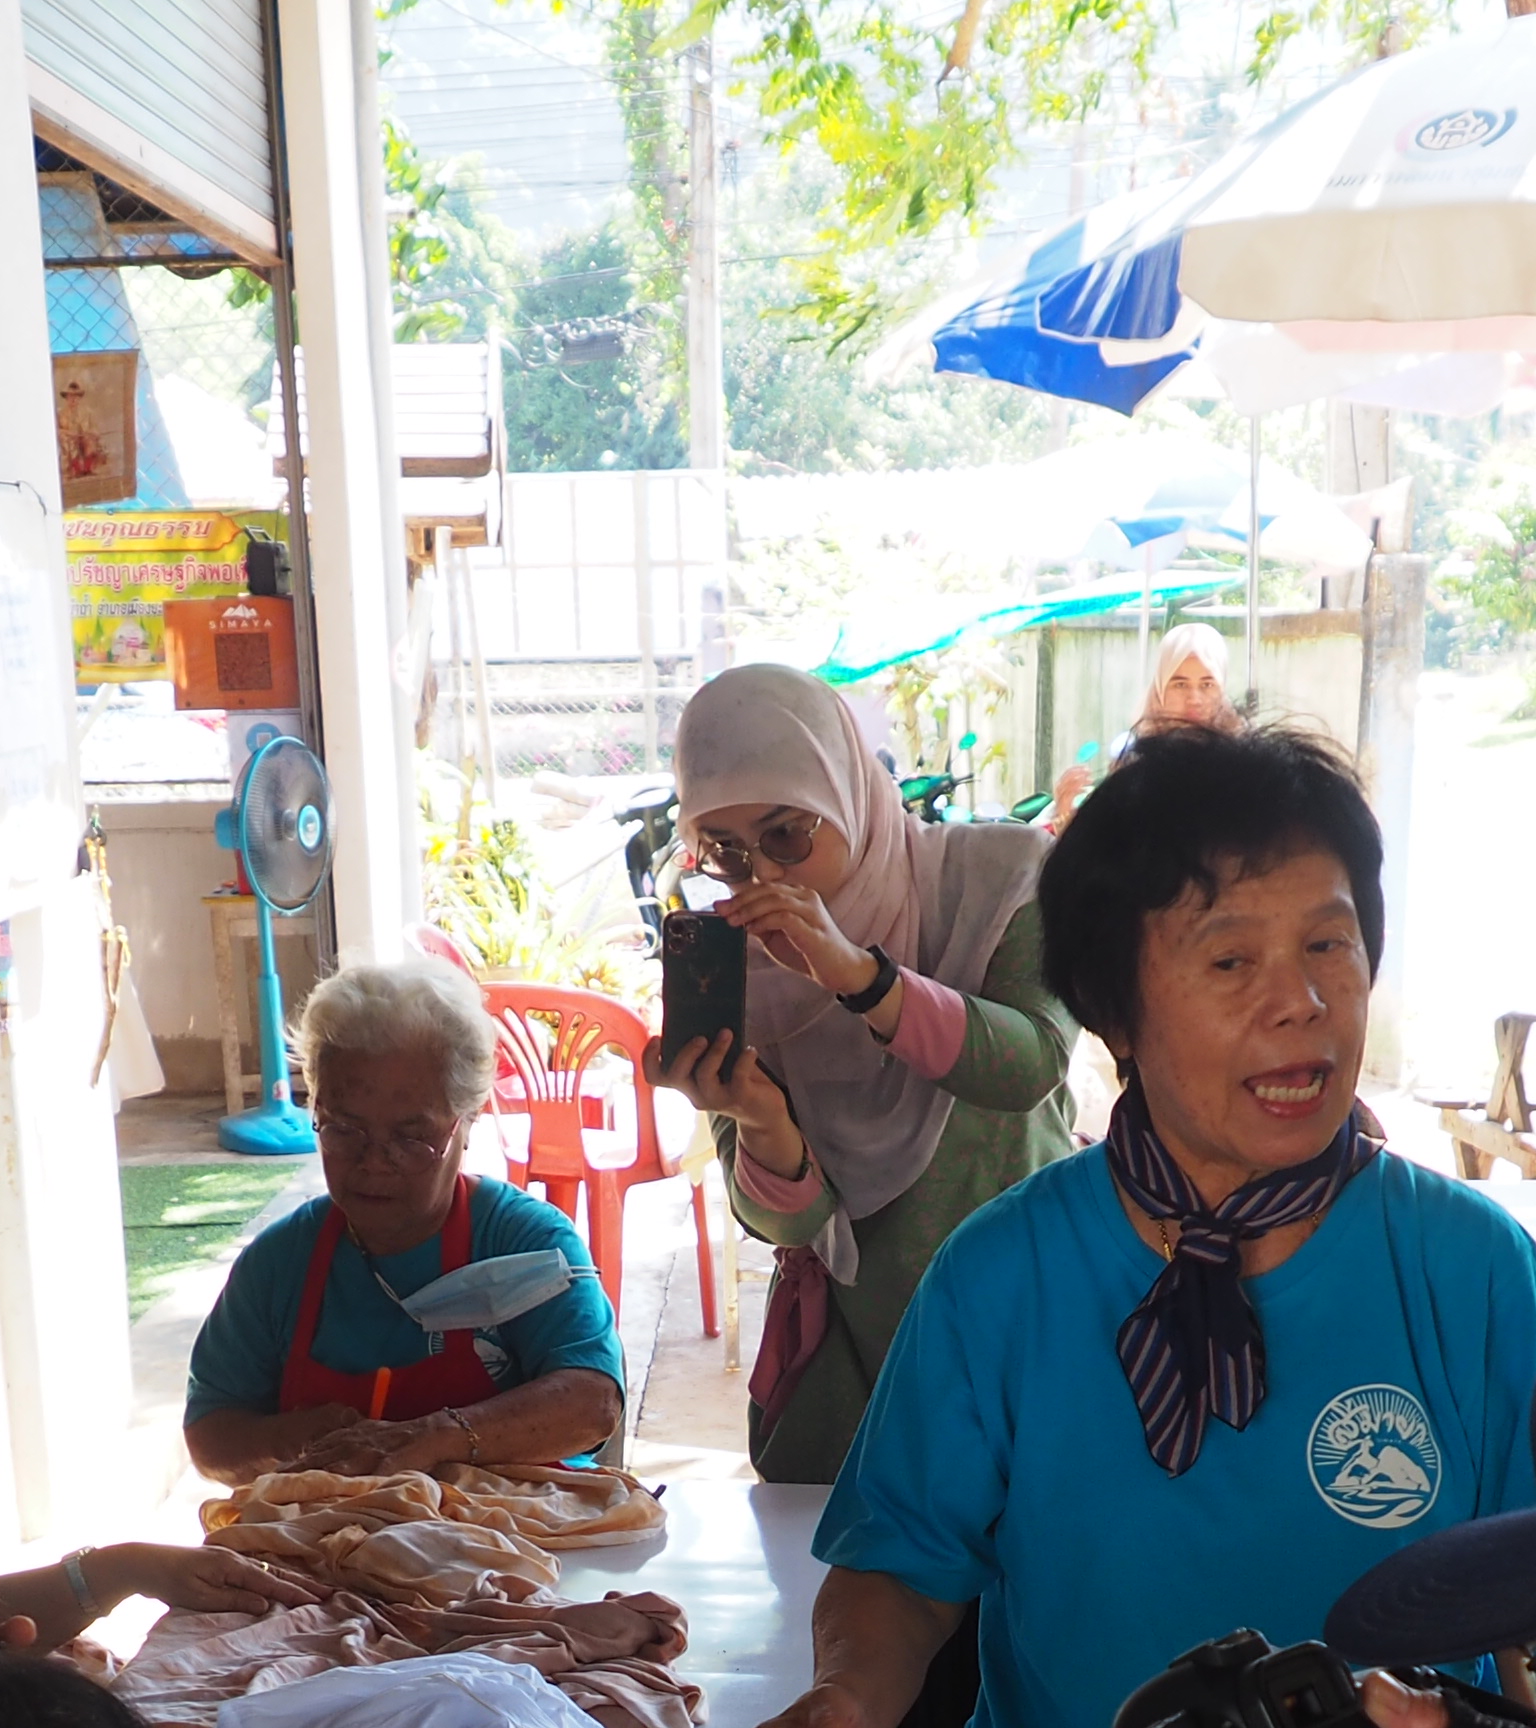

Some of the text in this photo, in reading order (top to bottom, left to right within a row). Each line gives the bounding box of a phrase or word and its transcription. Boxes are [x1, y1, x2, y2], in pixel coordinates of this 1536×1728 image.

[64, 518, 212, 546] ชนคุณธรรม
[208, 618, 273, 630] SIMAYA
